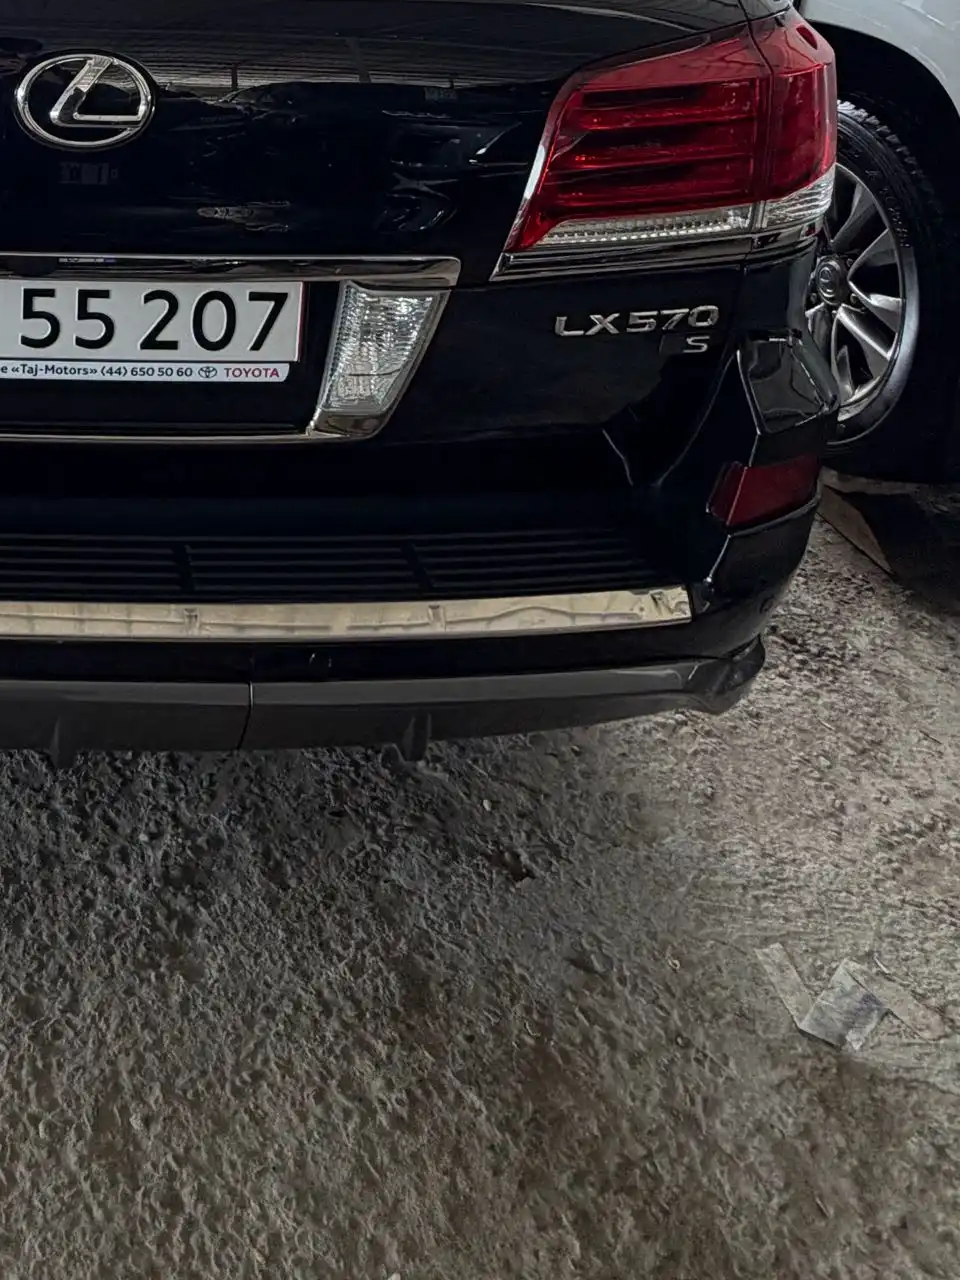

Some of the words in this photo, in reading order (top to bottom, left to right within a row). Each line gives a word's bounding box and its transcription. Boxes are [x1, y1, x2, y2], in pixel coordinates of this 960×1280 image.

[19, 287, 116, 350] 55
[139, 289, 289, 352] 207
[555, 312, 621, 337] LX
[626, 304, 720, 333] 570
[683, 335, 711, 354] S
[11, 363, 98, 376] «Taj-Motors»
[100, 365, 128, 377] (44)
[130, 366, 155, 377] 650
[157, 366, 174, 377] 50
[176, 366, 193, 377] 60
[224, 367, 280, 378] TOYOTA
